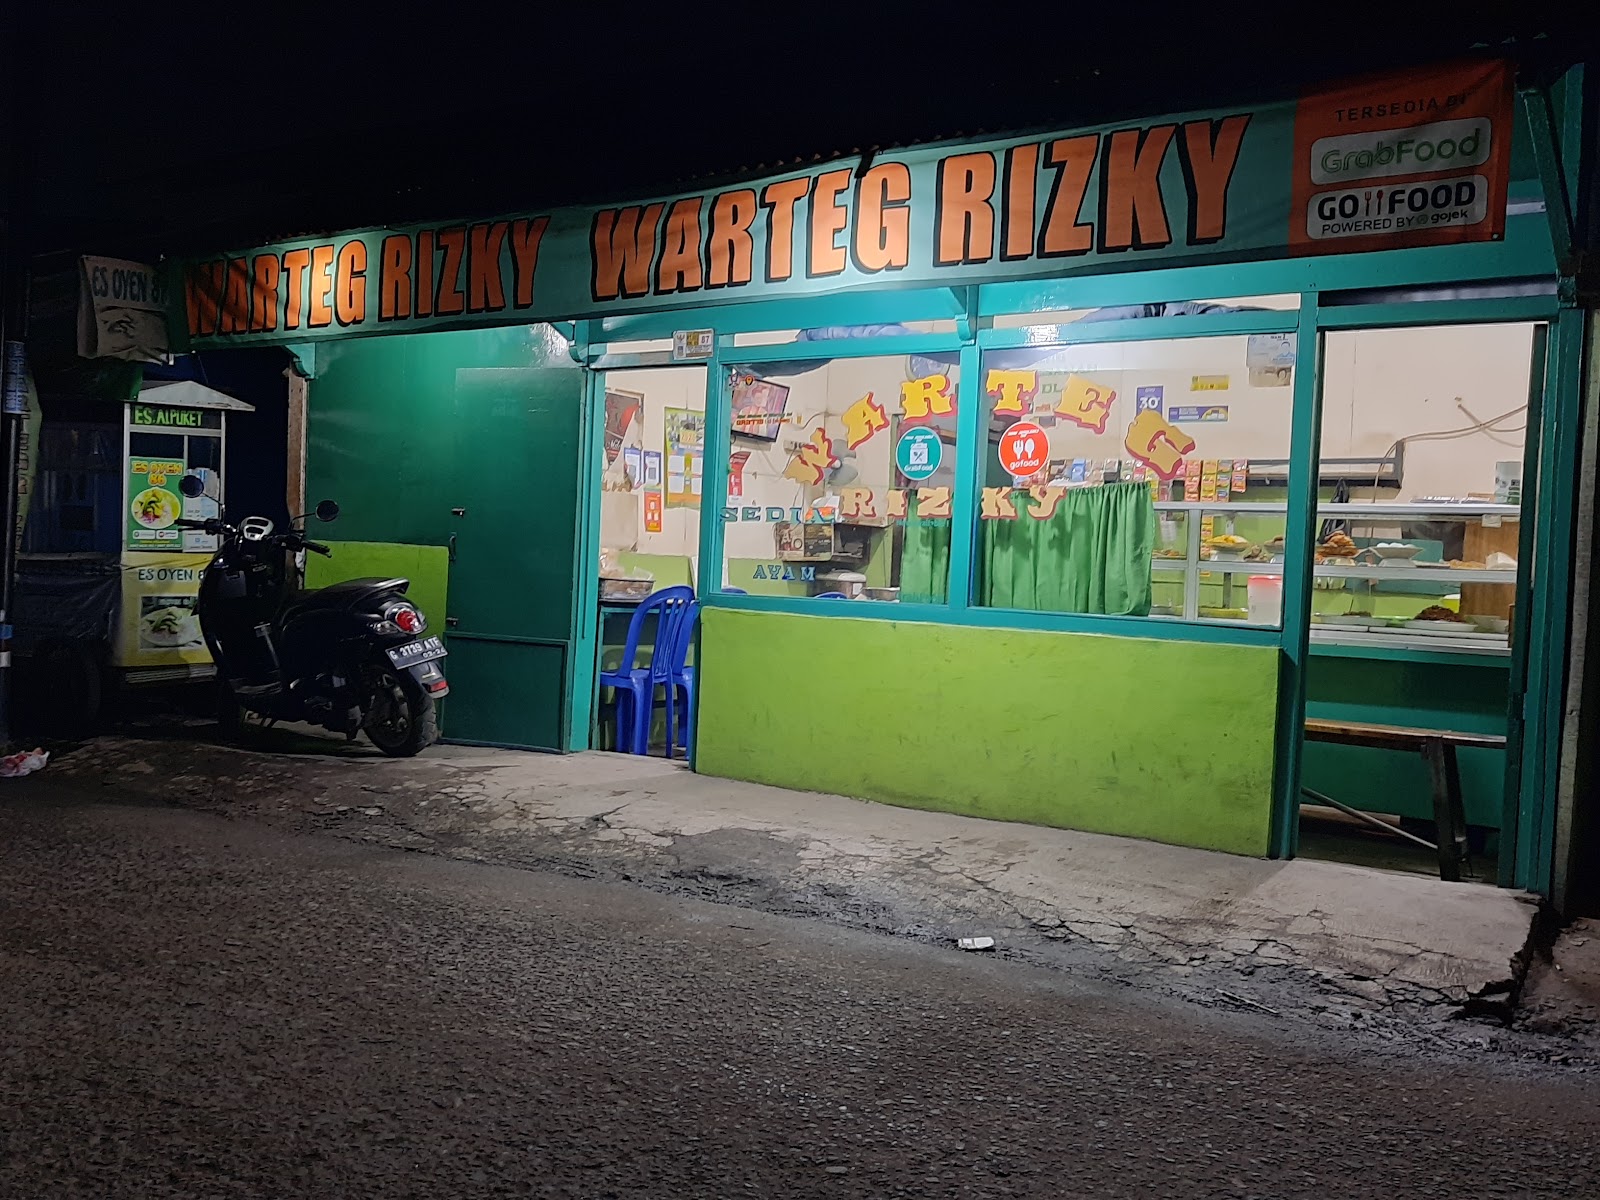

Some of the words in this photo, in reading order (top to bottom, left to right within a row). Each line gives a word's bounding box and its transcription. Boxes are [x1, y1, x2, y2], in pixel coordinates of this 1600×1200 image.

[1335, 98, 1438, 122] TERSEDIA
[1320, 127, 1481, 174] GrabFood
[1317, 194, 1360, 221] GO
[1387, 181, 1477, 215] FOOD
[184, 239, 367, 337] WARTEG
[379, 216, 550, 322] RIZKY
[592, 163, 911, 303] WARTEG
[932, 114, 1251, 268] RIZKY
[1321, 218, 1392, 236] POWERED
[1396, 215, 1415, 228] BY
[1430, 209, 1469, 224] gojek
[92, 265, 108, 298] ES
[112, 268, 147, 302] OYEN
[132, 461, 149, 474] ES
[1009, 458, 1040, 470] gofood
[840, 486, 1067, 521] RIZKY
[138, 568, 154, 581] ES
[157, 568, 193, 581] OYEN
[753, 564, 816, 581] AYAM
[400, 643, 422, 656] 3739
